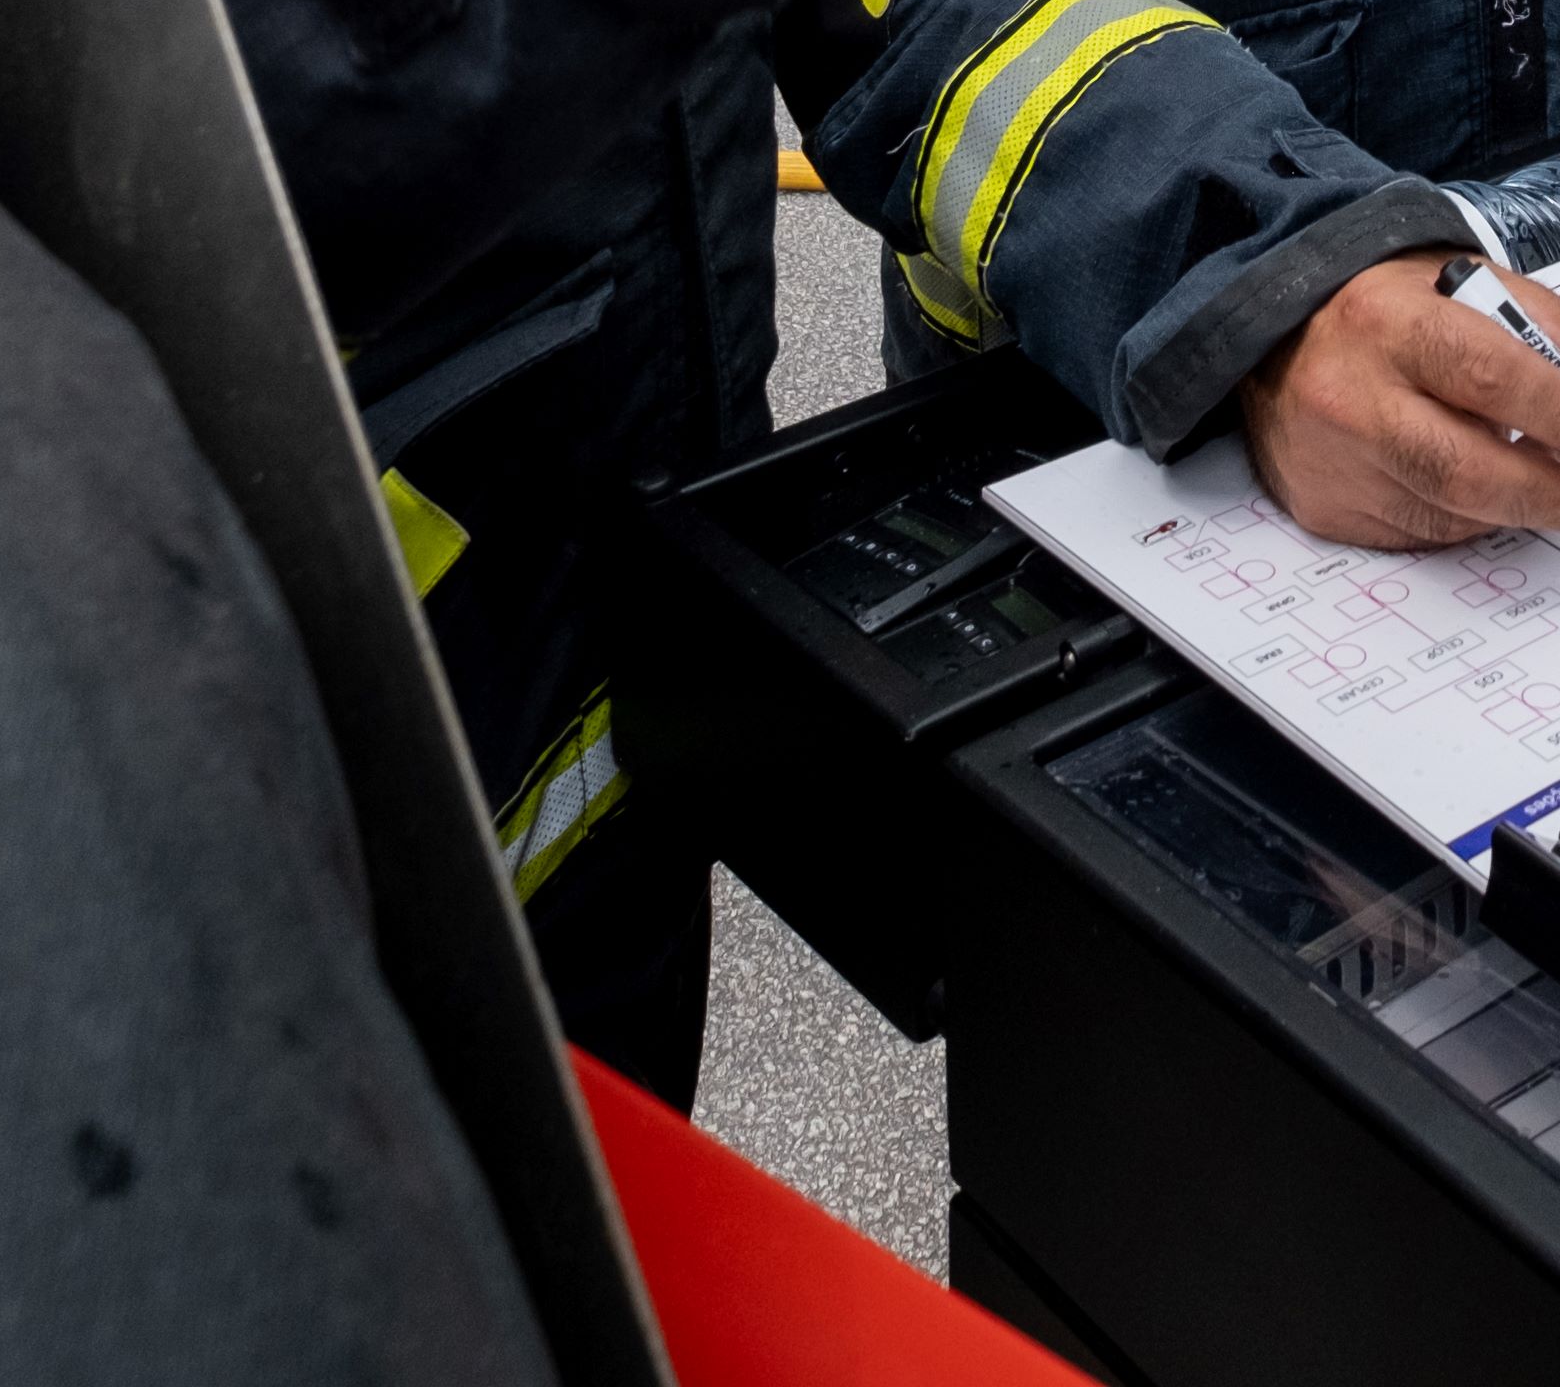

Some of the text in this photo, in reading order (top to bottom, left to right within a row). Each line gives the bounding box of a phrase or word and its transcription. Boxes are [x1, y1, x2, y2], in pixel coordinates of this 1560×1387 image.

[1254, 646, 1284, 664] ERAS
[1426, 636, 1464, 661] CELOP
[1338, 675, 1385, 703] CEPLAN
[1472, 670, 1504, 690] COS
